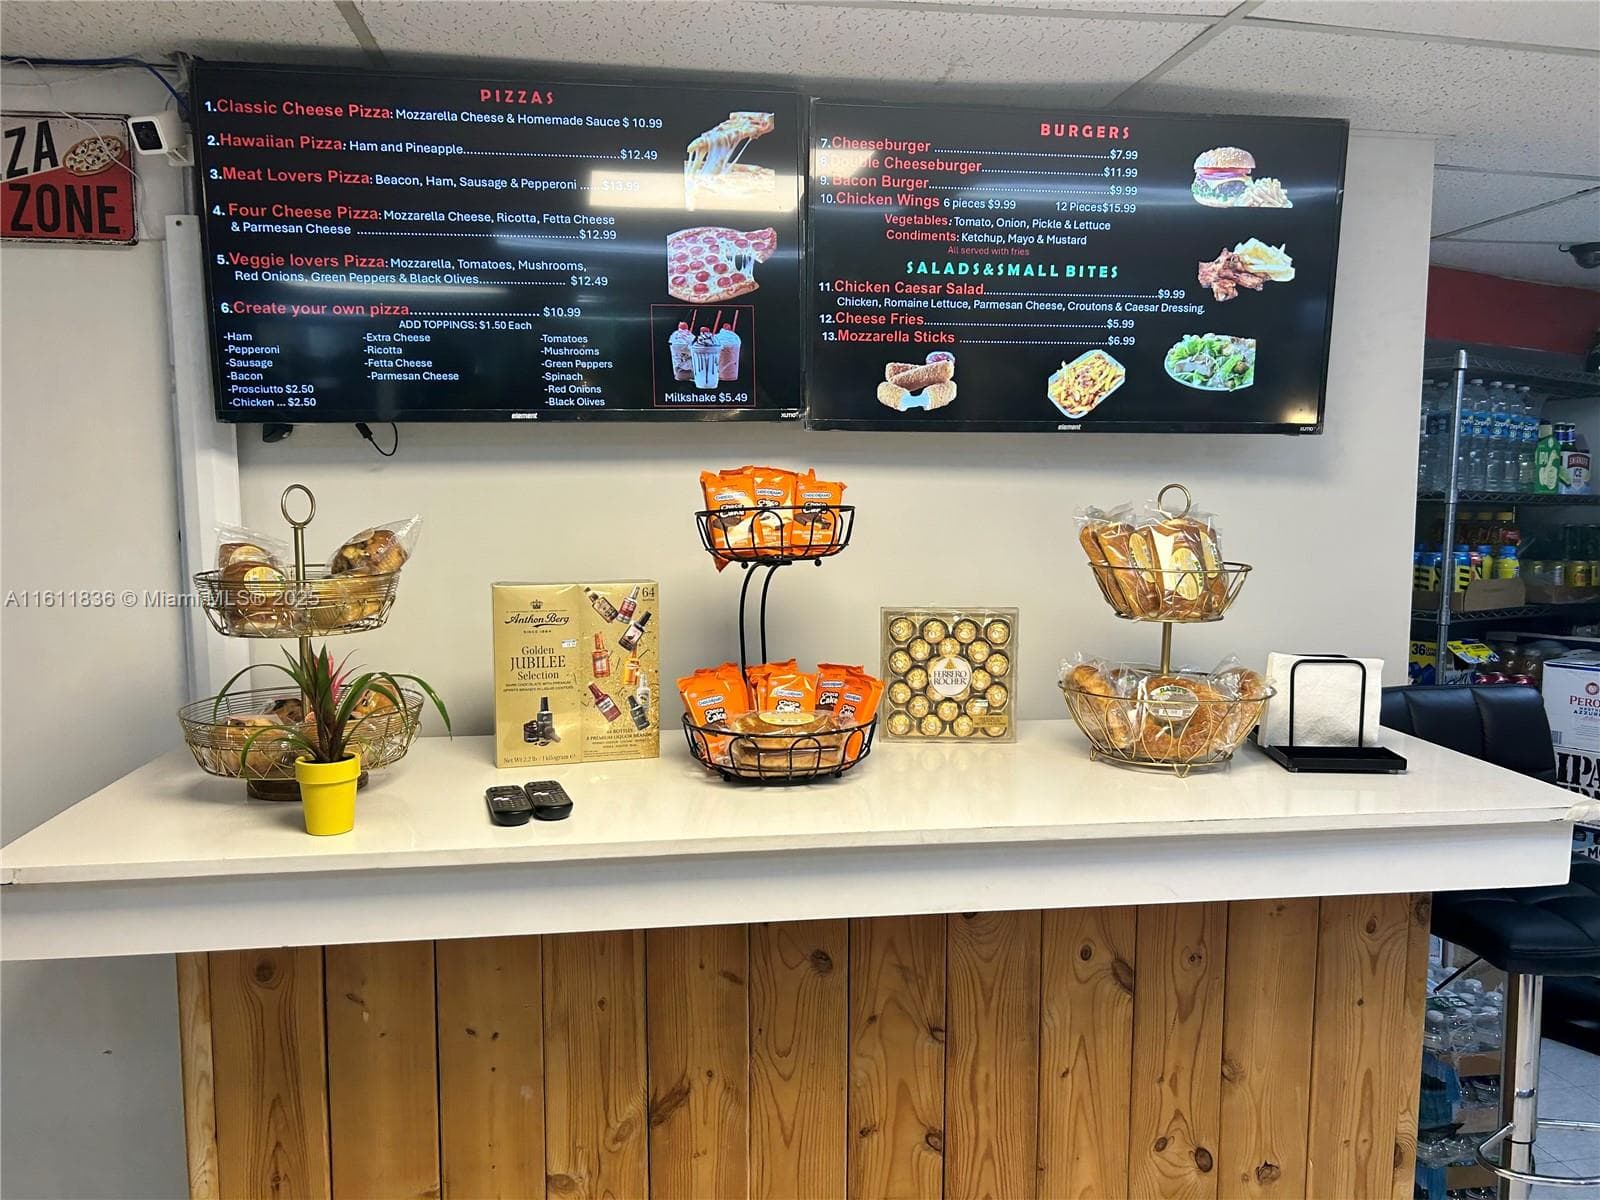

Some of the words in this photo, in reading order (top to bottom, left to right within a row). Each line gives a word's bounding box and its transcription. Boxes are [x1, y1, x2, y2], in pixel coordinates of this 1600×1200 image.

[480, 89, 554, 104] PIZZAS
[282, 102, 343, 117] Cheese
[348, 105, 393, 119] Pizza:
[396, 109, 458, 122] Mozzarella
[460, 111, 504, 124] Cheese
[507, 113, 515, 124] &
[518, 113, 583, 126] Homemade
[586, 116, 620, 128] Sauce
[1040, 123, 1129, 139] BURGERS
[0, 120, 59, 180] ZA
[300, 136, 346, 151] Pizza:
[350, 141, 378, 152] Ham
[381, 142, 403, 152] and
[620, 149, 658, 161] $12.49
[1110, 149, 1138, 160] $7.99
[884, 156, 982, 174] Cheeseburger
[1103, 168, 1138, 178] $11.99
[267, 168, 322, 183] Lovers
[328, 170, 372, 185] Pizza:
[375, 174, 423, 187] Beacon,
[426, 175, 457, 188] Ham,
[459, 176, 508, 189] Sausage
[510, 178, 518, 188] &
[521, 178, 576, 191] Pepperoni
[832, 175, 877, 187] Bacon
[881, 176, 929, 191] Burger
[1110, 186, 1138, 196] $9.99
[9, 183, 120, 234] ZONE
[896, 193, 940, 209] Wings
[952, 200, 985, 210] pieces
[987, 200, 1016, 210] $9.99
[1055, 202, 1068, 211] 12
[228, 203, 267, 218] Four
[272, 204, 332, 219] Cheese
[337, 206, 382, 220] Pizza:
[384, 211, 444, 222] Mozzarella
[448, 212, 494, 224] Cheese,
[497, 213, 540, 225] Ricotta,
[543, 214, 572, 224] Fetta
[575, 214, 615, 225] Cheese
[884, 214, 952, 227] Vegetables:
[954, 217, 994, 228] Tomato,
[996, 218, 1029, 229] Onion,
[1032, 219, 1061, 229] Pickle
[1064, 220, 1072, 229] &
[1074, 220, 1111, 230] Lettuce
[231, 222, 240, 232] &
[243, 222, 303, 234] Parmesan
[306, 224, 351, 235] Cheese
[579, 229, 616, 241] $12.99
[886, 229, 959, 242] Condiments:
[961, 233, 1006, 245] Ketchup,
[1008, 234, 1034, 245] Mayo
[1037, 234, 1044, 244] &
[1046, 235, 1087, 245] Mustard
[289, 253, 339, 267] lovers
[344, 255, 389, 268] Pizza:
[390, 258, 455, 270] Mozzarella,
[457, 259, 516, 271] Tomatoes,
[518, 260, 587, 272] Mushrooms,
[235, 271, 258, 281] Red
[261, 272, 309, 283] Onions,
[311, 272, 346, 283] Green
[349, 273, 395, 284] Peppers
[399, 274, 408, 283] &
[410, 273, 441, 283] Black
[443, 274, 479, 284] Olives
[570, 276, 608, 287] $12.49
[1066, 265, 1118, 279] BITES
[894, 281, 942, 294] Caesar
[946, 283, 984, 295] Salad
[1158, 289, 1185, 299] $9.99
[292, 303, 327, 317] your
[333, 304, 364, 315] own
[370, 303, 409, 317] pizza
[543, 307, 581, 318] $10.99
[836, 297, 882, 308] Chicken,
[884, 298, 928, 308] Romaine
[930, 299, 971, 310] Lettuce,
[974, 300, 1023, 310] Parmesan
[1025, 302, 1065, 312] Cheese,
[1068, 302, 1113, 312] Croutons
[1115, 303, 1123, 311] &
[1125, 303, 1159, 312] Caesar
[1161, 303, 1205, 315] Dressing.
[399, 320, 422, 329] ADD
[424, 320, 478, 330] TOPPINGS:
[479, 320, 506, 330] $1.50
[508, 321, 532, 330] Each
[890, 313, 924, 326] Fries
[1107, 319, 1135, 329] $5.99
[393, 333, 431, 342] Cheese
[913, 331, 955, 344] Sticks
[1107, 336, 1135, 346] $6.99
[395, 359, 432, 368] Cheese
[575, 360, 613, 370] Peppers
[422, 372, 459, 381] Cheese
[285, 385, 314, 394] $2.50
[568, 385, 601, 394] Onions
[287, 398, 316, 407] $2.50
[577, 397, 605, 406] Olives
[665, 393, 716, 403] Milkshake
[718, 392, 748, 403] $5.49
[642, 587, 655, 598] 64
[504, 612, 546, 625] Anthon
[546, 612, 570, 625] Berg
[521, 645, 554, 656] Golden
[1412, 643, 1426, 656] 36
[510, 655, 566, 671] JUBILEE
[517, 670, 559, 681] Selection
[819, 695, 838, 705] Cake
[1569, 695, 1600, 708] PERO
[706, 712, 727, 724] Cake
